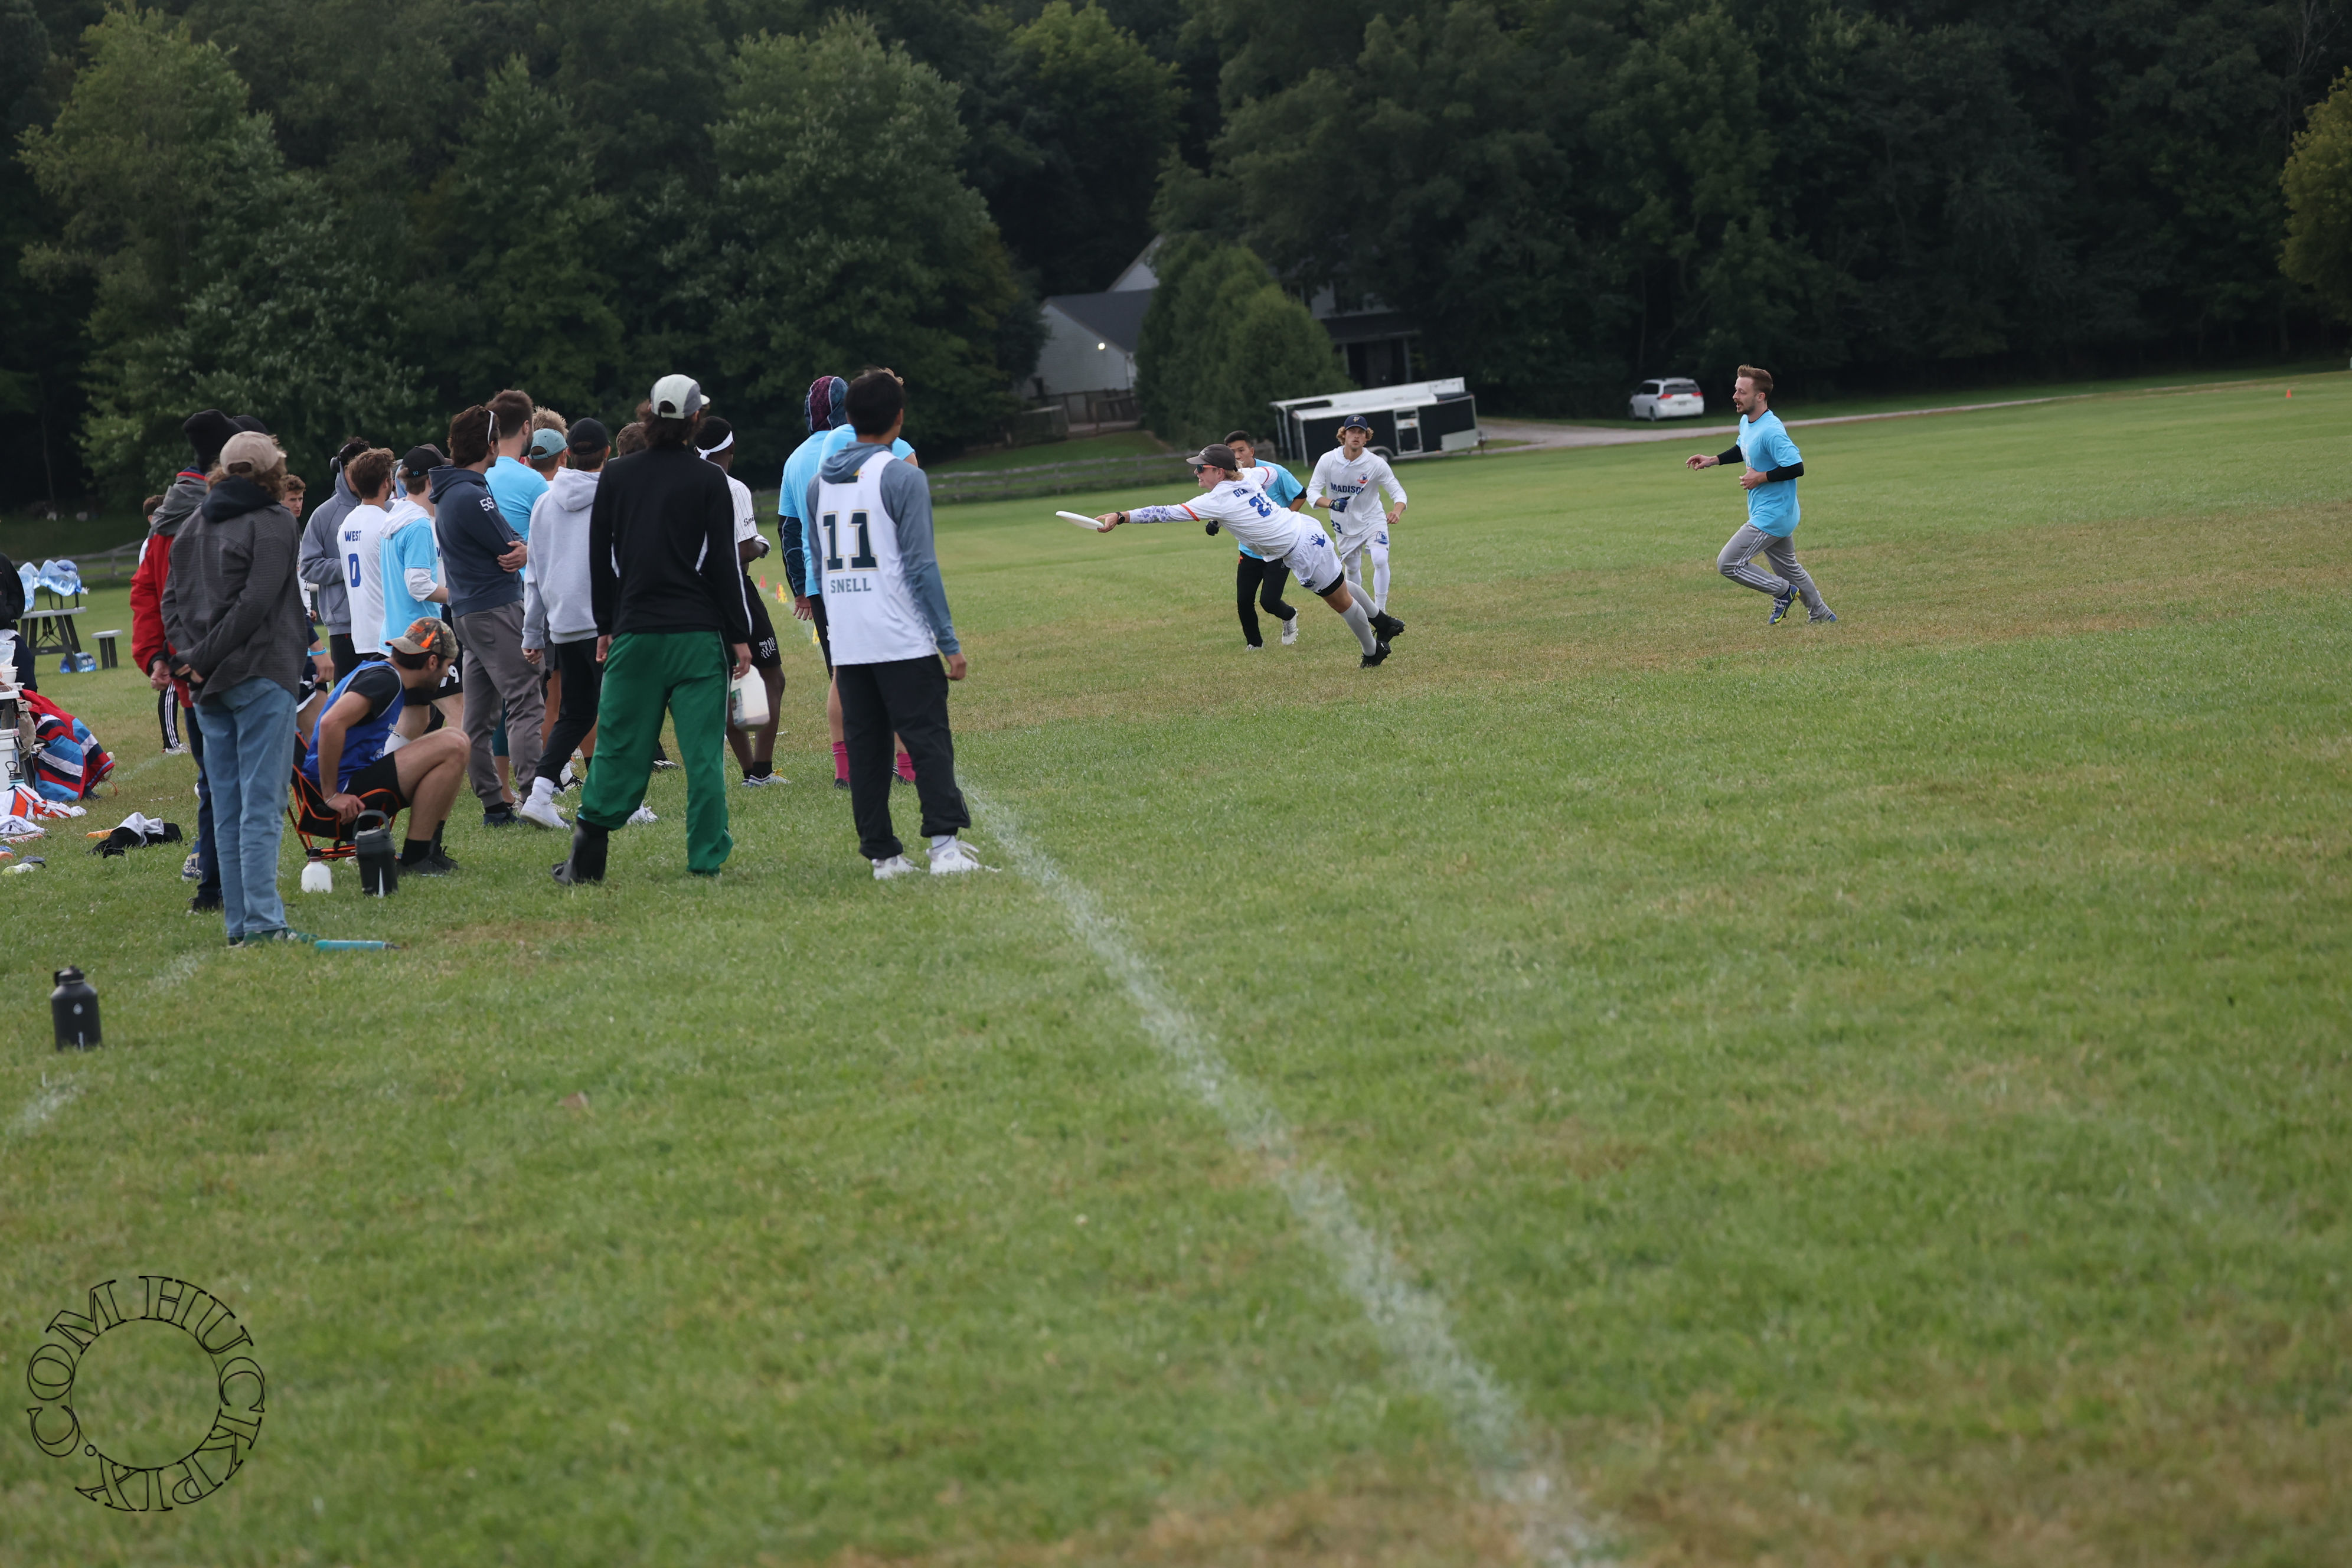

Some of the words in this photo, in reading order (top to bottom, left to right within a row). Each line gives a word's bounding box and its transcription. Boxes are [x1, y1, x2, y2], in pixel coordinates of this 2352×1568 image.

[344, 530, 362, 541] WEST
[822, 509, 879, 574] 11
[348, 553, 361, 588] 0
[830, 577, 872, 594] SNELL
